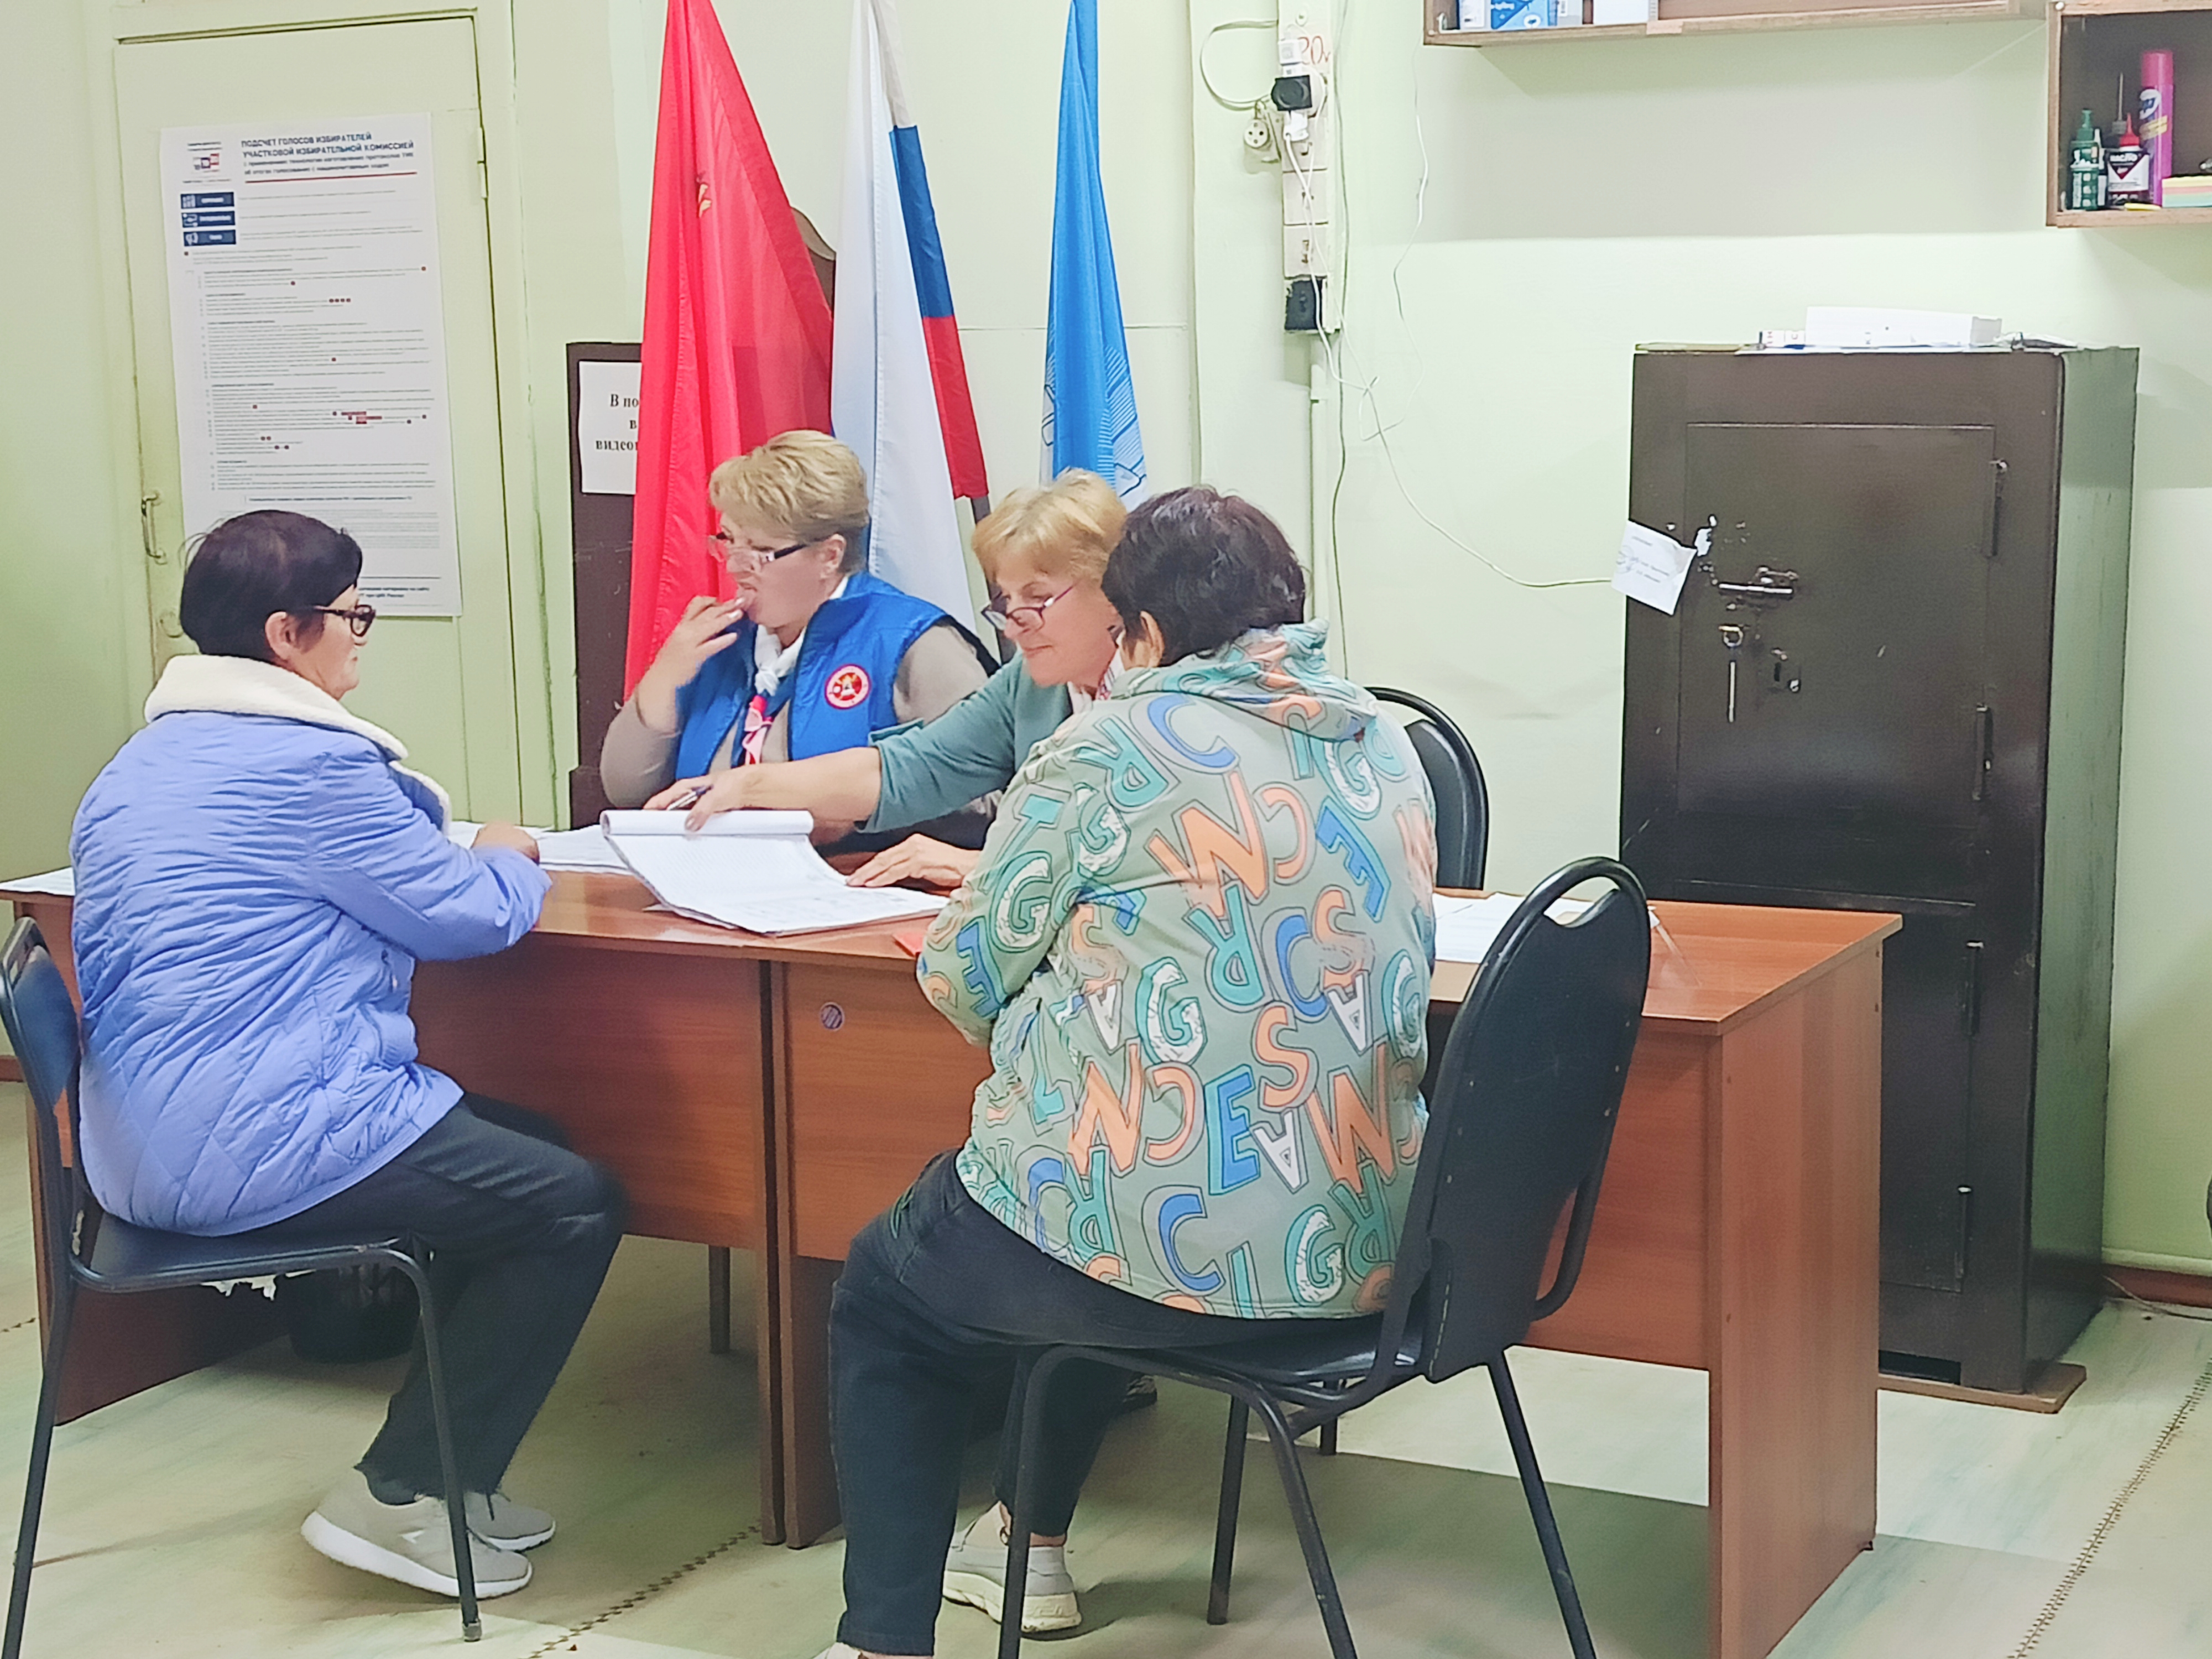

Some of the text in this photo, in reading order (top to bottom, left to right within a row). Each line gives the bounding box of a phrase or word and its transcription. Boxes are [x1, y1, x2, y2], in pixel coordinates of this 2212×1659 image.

[241, 132, 372, 148] ПОДСЧЕТ ГОЛОСОВ ИЗБИРАТЕЛЕЙ
[243, 140, 414, 158] УЧАСТКОВОЙ ИЗБИРАТЕЛЬНОЙ КОМИССИЕЙ
[610, 394, 619, 408] В
[1204, 1063, 1261, 1196] E
